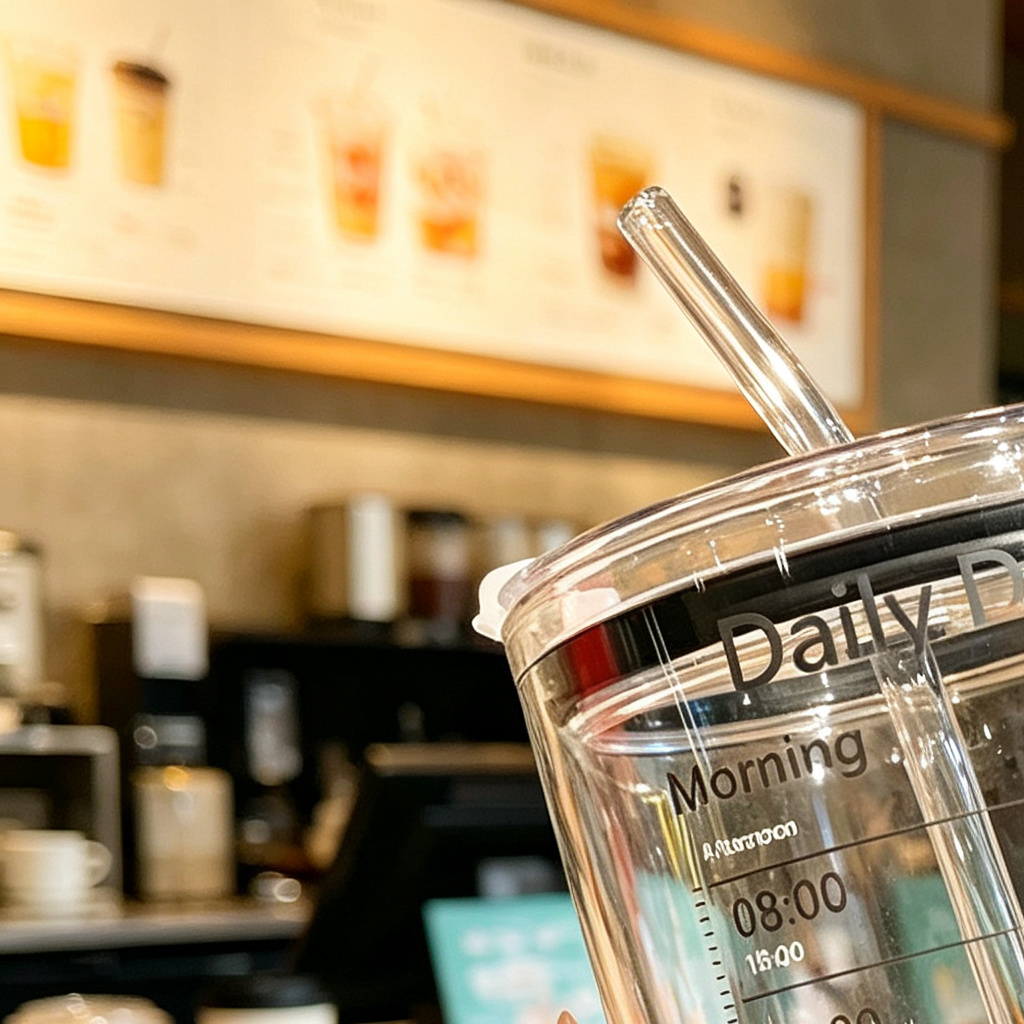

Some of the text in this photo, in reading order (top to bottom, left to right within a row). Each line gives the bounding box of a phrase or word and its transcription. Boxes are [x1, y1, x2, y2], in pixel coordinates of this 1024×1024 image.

[718, 573, 932, 691] Daily
[665, 728, 868, 815] Morning
[732, 872, 848, 938] 08:00
